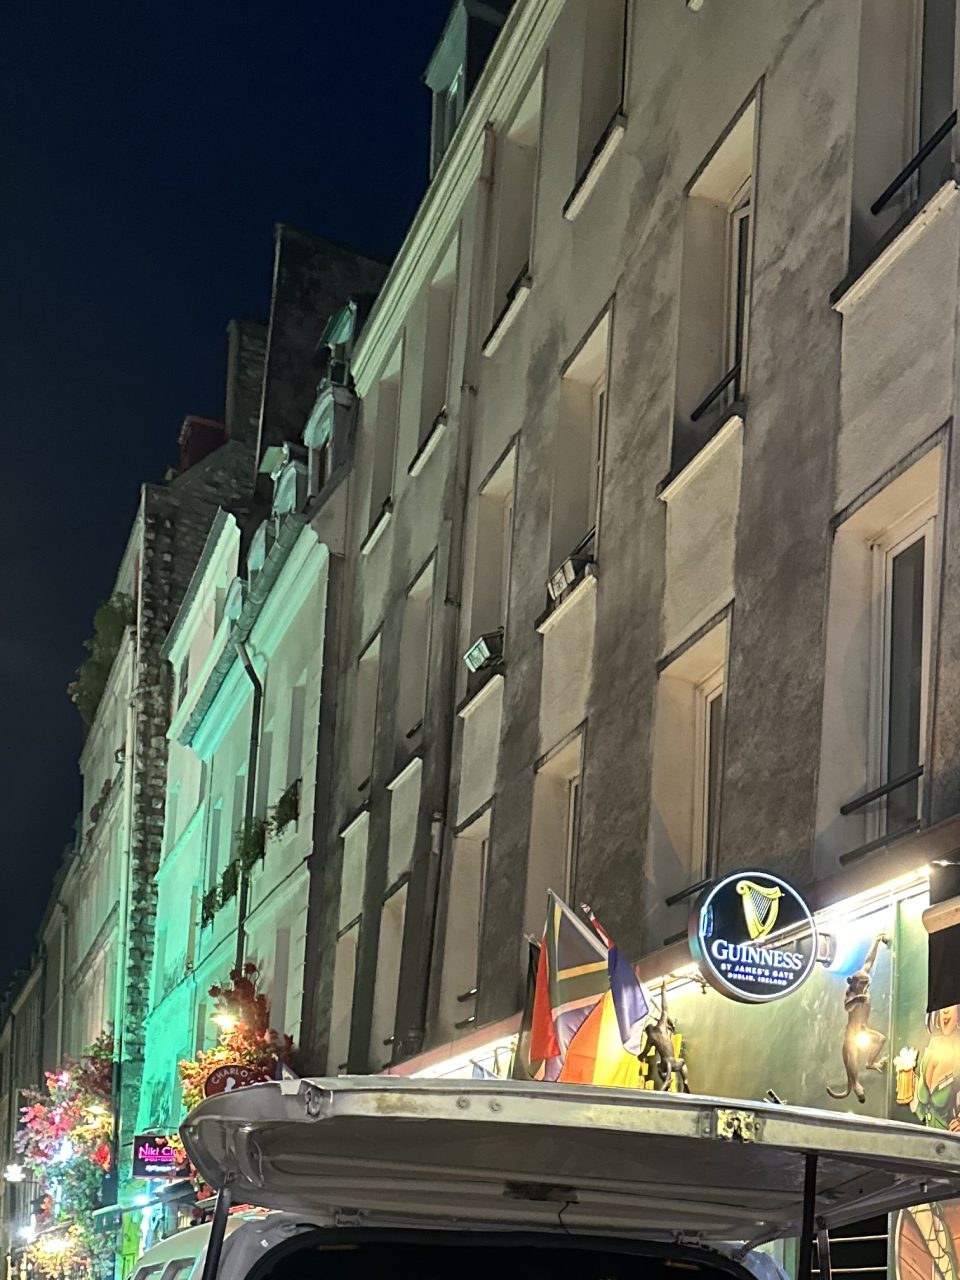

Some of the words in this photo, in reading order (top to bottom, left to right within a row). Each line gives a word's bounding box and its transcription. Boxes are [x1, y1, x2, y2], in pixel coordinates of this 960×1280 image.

[711, 939, 804, 970] GUINNESS
[720, 962, 732, 971] ST
[734, 964, 770, 976] JAMES'S
[772, 971, 794, 980] GATE
